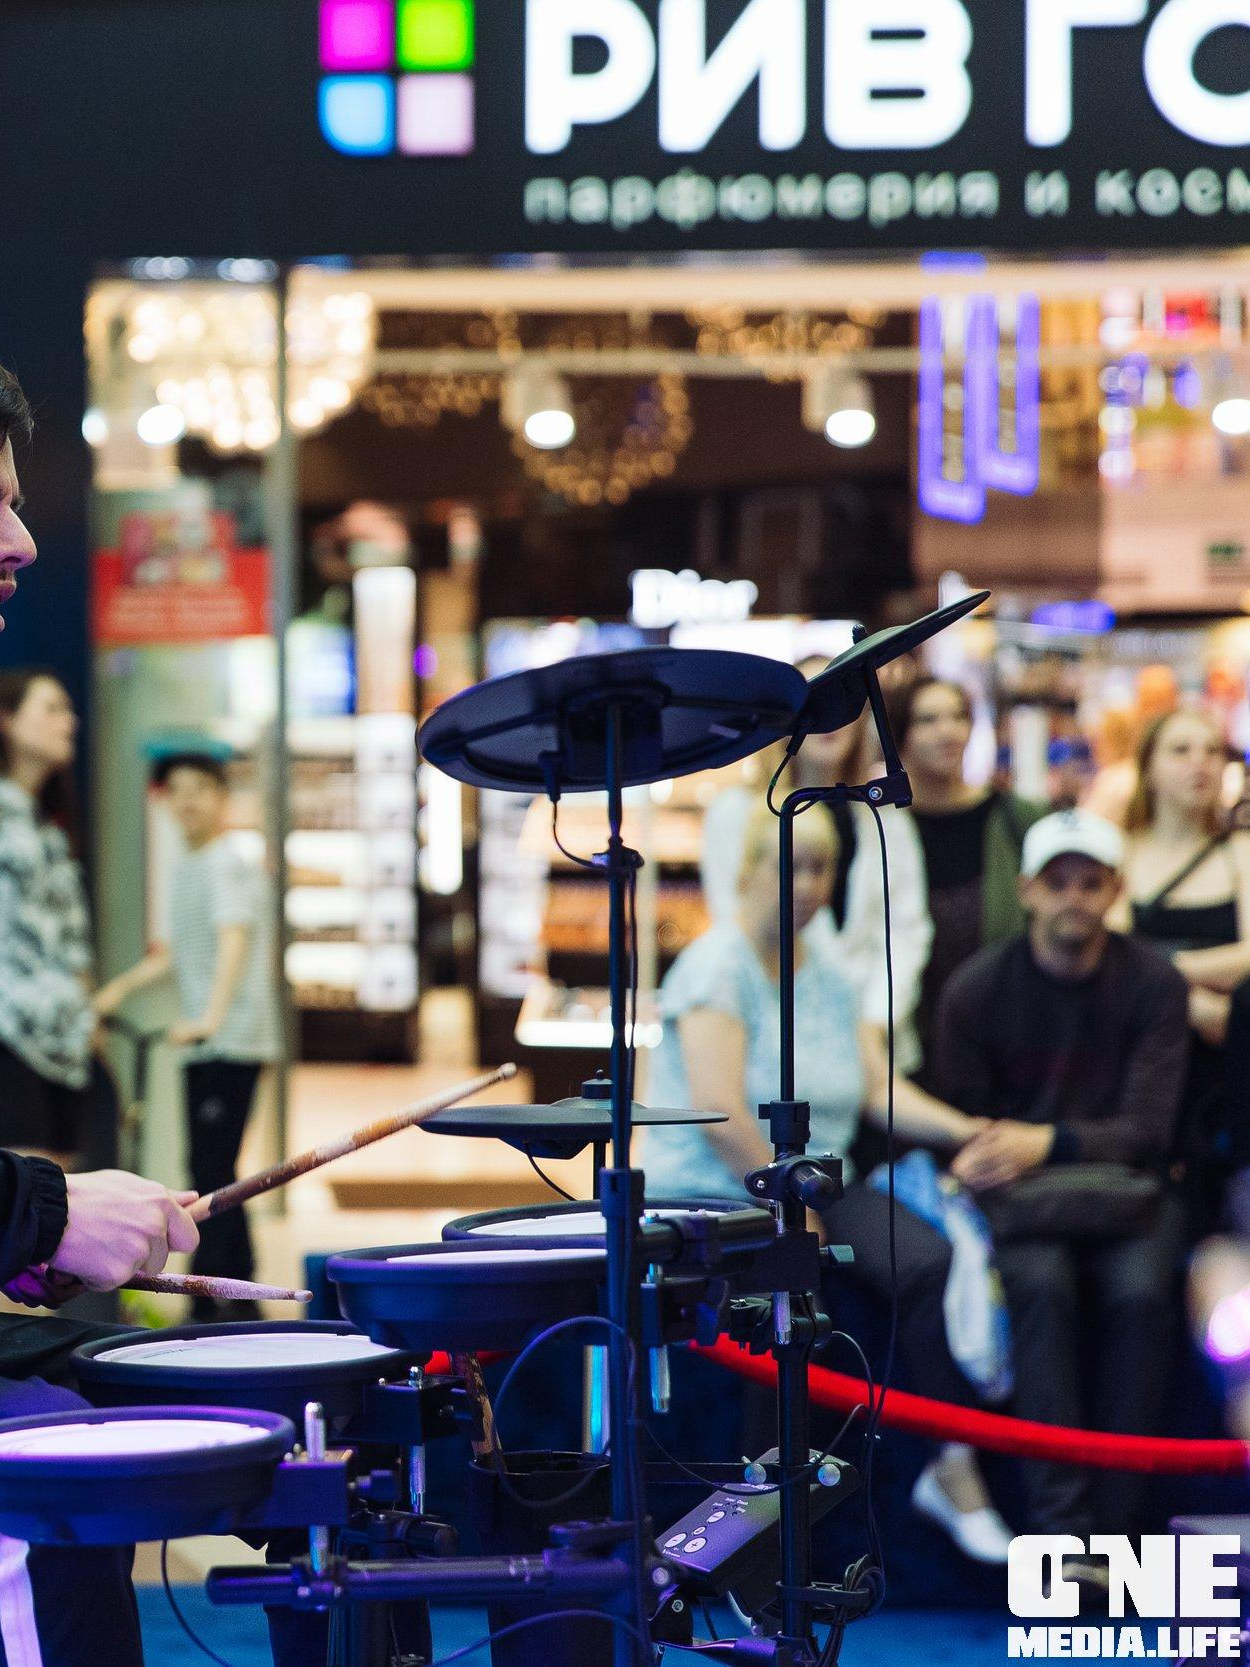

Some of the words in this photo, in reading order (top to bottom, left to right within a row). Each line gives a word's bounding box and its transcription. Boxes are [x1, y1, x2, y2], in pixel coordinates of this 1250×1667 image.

[524, 0, 974, 154] РИВ
[524, 166, 1000, 231] парфюмерия
[1024, 169, 1070, 218] и
